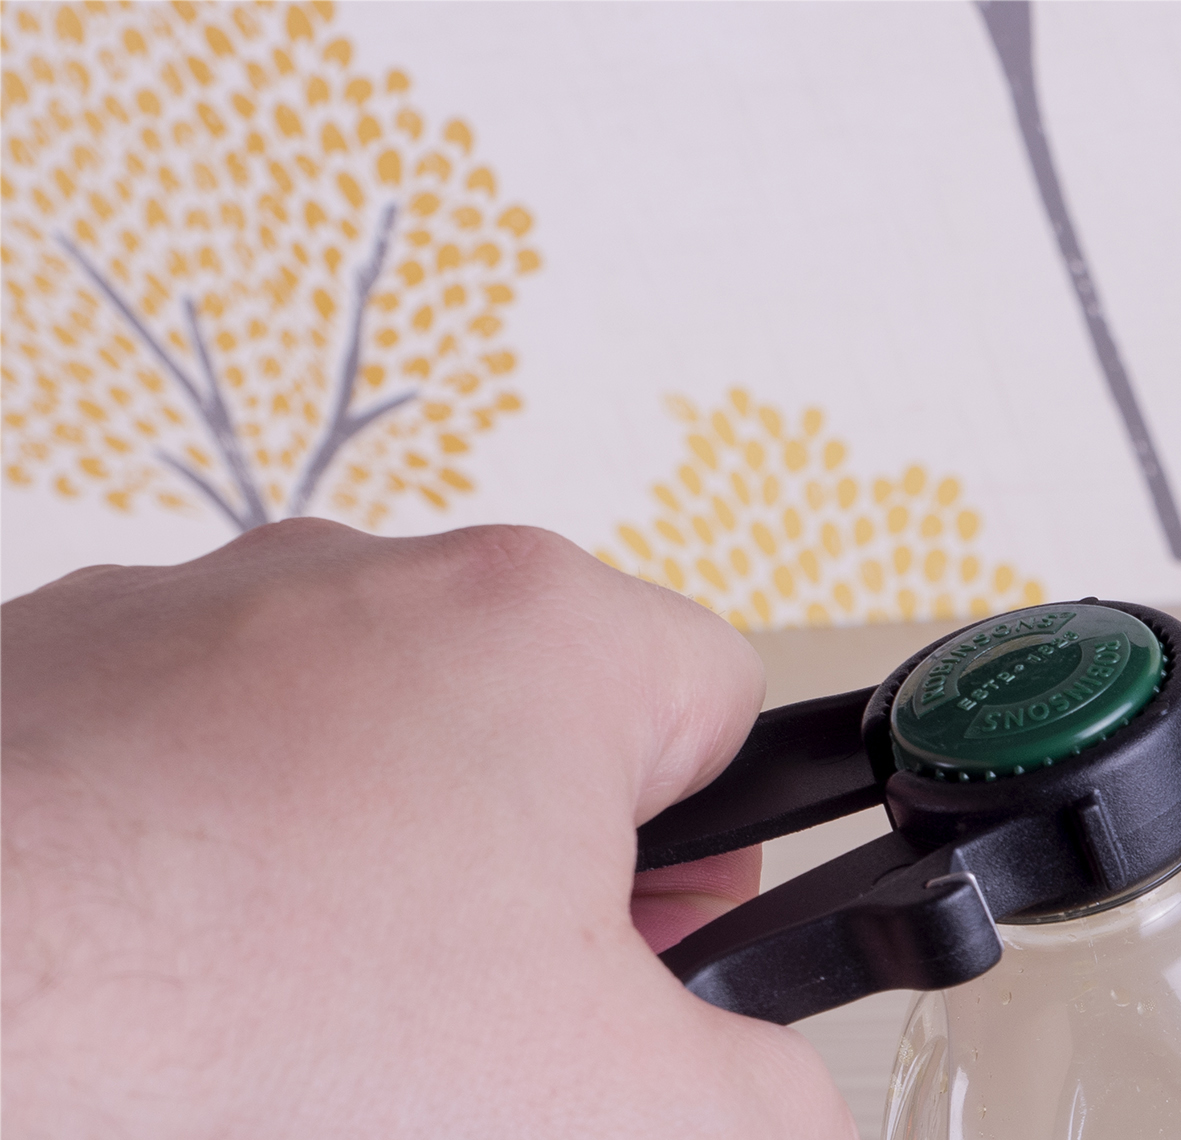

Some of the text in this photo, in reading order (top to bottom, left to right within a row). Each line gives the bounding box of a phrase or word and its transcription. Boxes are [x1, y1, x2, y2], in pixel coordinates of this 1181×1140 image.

[921, 612, 1058, 704] ROBINSONS
[980, 639, 1122, 733] ROBINSONS
[1027, 630, 1080, 662] 1823
